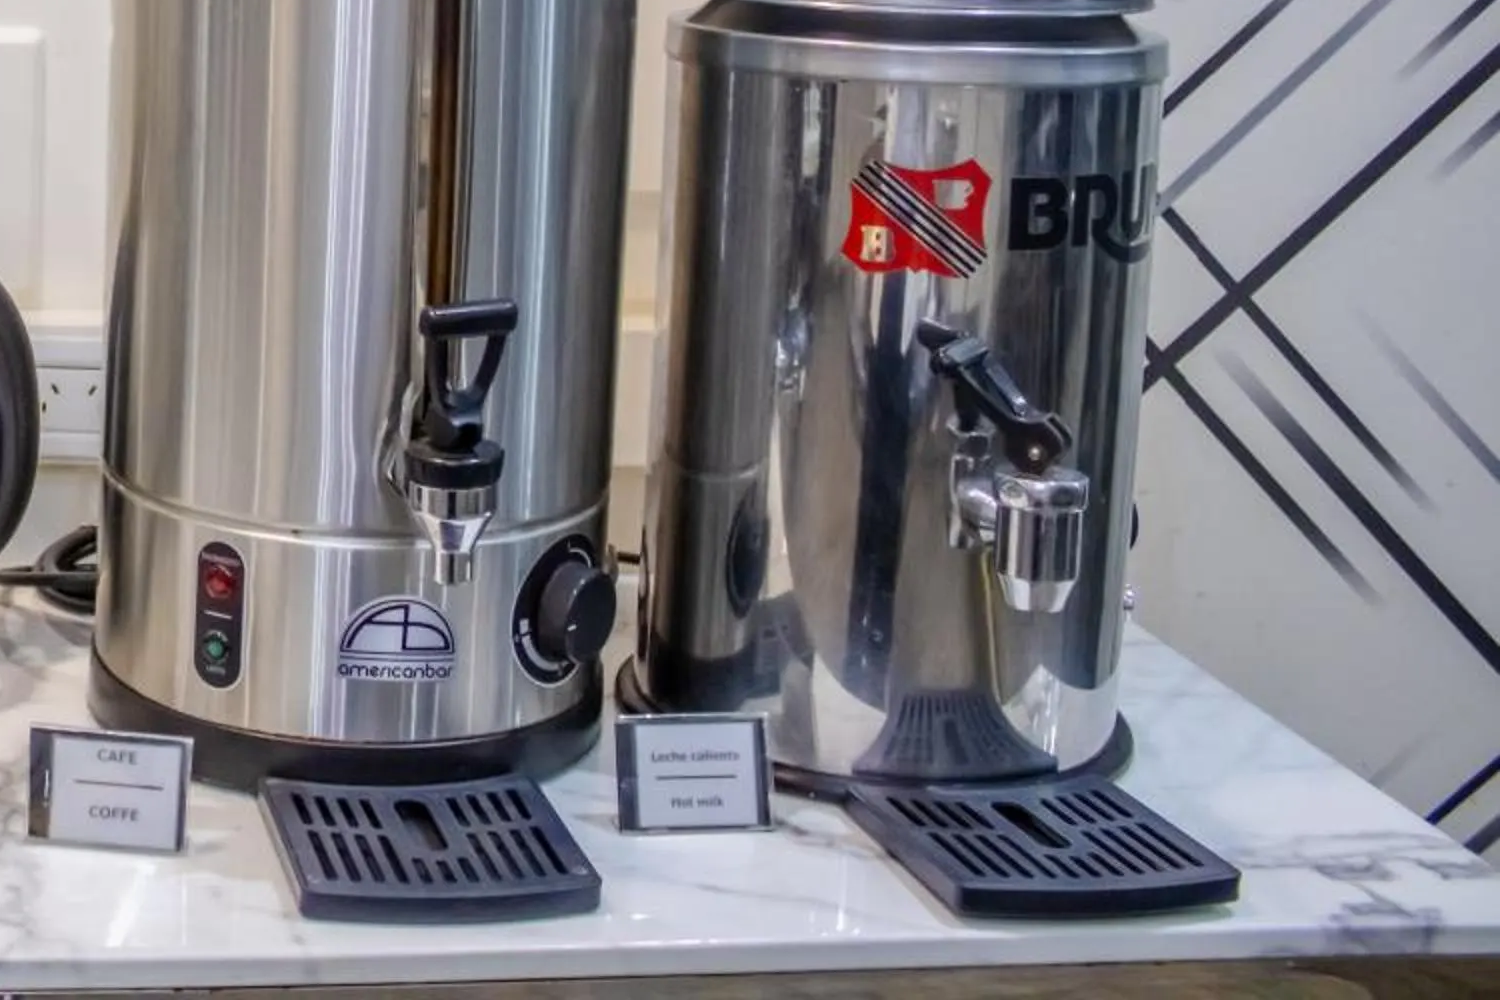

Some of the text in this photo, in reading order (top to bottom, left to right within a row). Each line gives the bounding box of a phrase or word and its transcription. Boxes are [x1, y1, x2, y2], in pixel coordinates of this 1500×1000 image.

[338, 663, 453, 679] americanbar
[97, 748, 138, 765] CAFE
[651, 751, 687, 763] Leche
[696, 795, 724, 808] milk
[88, 804, 139, 822] COFFE
